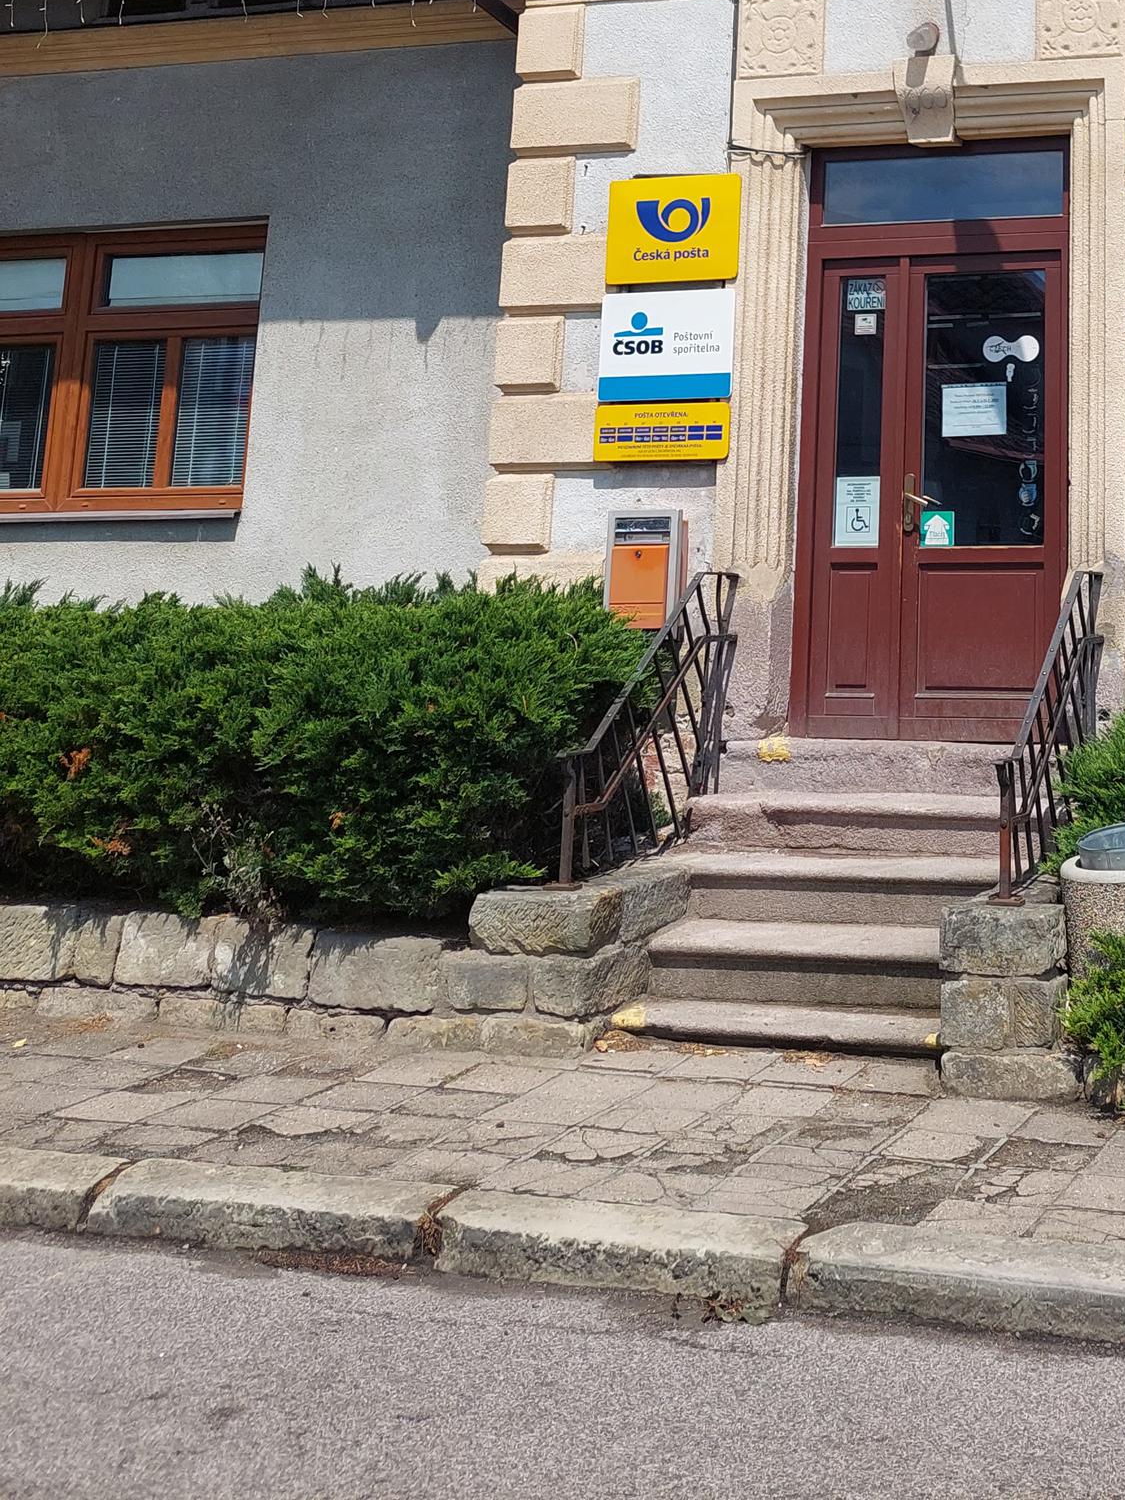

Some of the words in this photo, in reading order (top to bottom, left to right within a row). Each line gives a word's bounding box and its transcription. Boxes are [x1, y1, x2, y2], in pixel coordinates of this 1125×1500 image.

[633, 248, 670, 261] Česká
[674, 247, 709, 261] pošta
[674, 331, 713, 341] Poštovní
[612, 339, 663, 356] ČSOB
[672, 343, 720, 356] spořitelna
